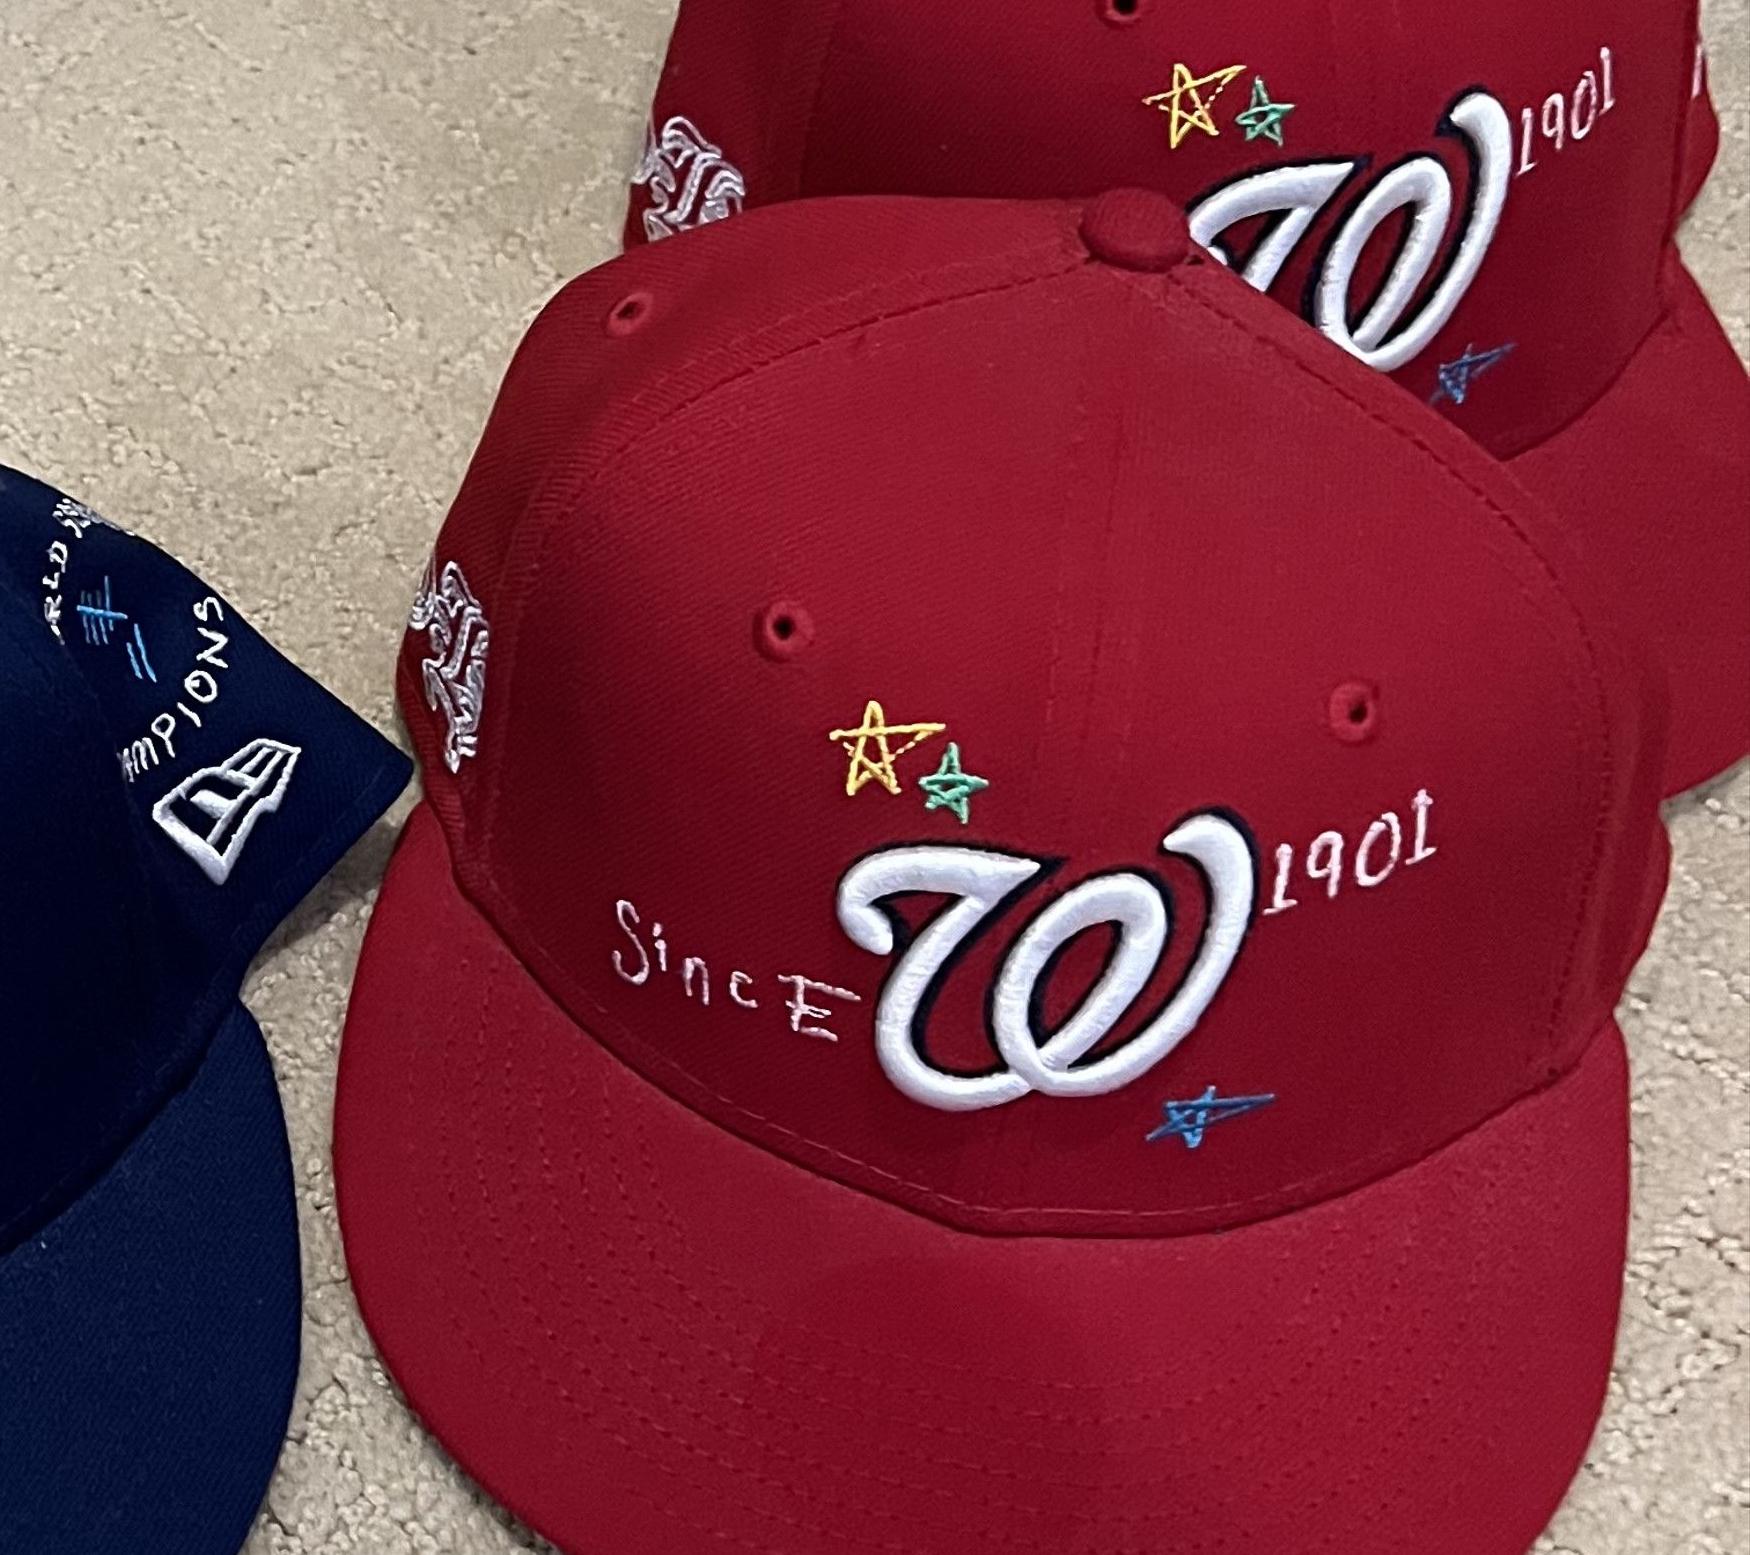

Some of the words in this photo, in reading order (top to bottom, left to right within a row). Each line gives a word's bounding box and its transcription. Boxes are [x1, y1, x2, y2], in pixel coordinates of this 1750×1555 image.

[1516, 46, 1615, 177] 1901
[1186, 84, 1513, 374] W
[1262, 788, 1439, 918] 1901
[836, 804, 1260, 1113] W
